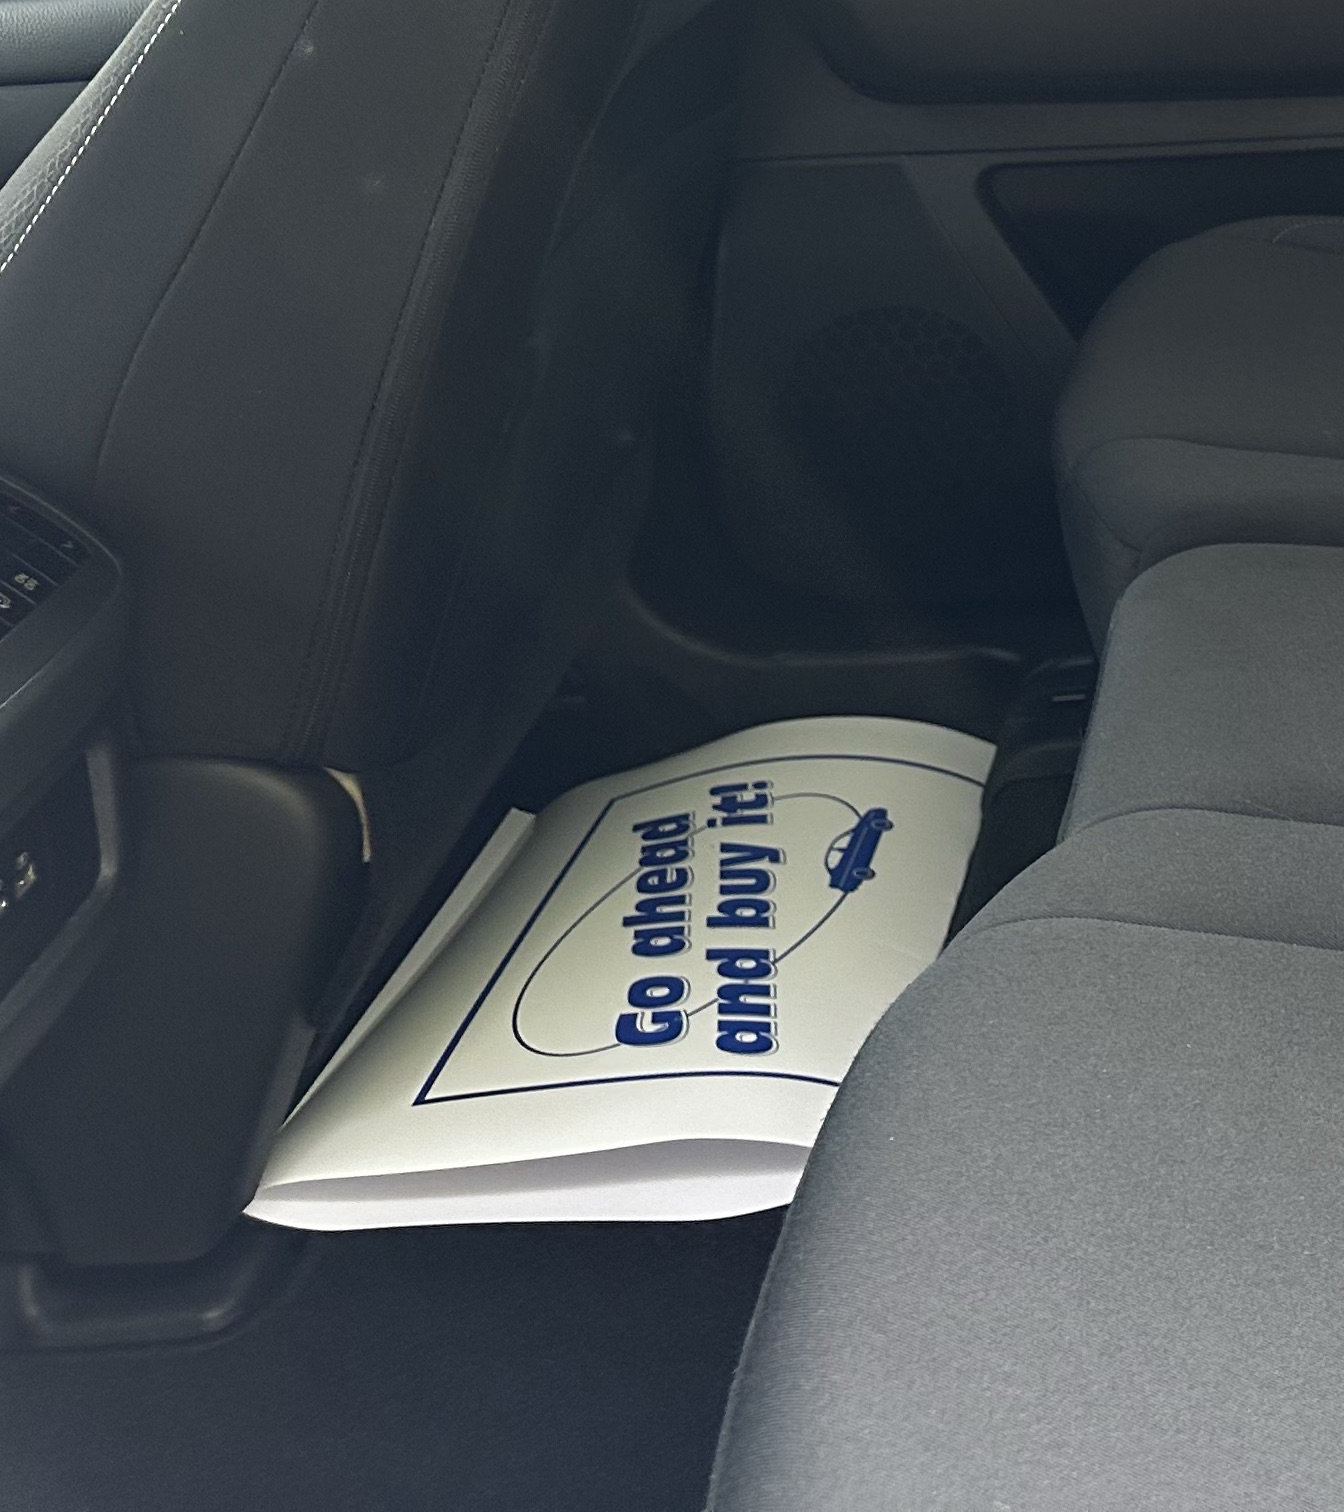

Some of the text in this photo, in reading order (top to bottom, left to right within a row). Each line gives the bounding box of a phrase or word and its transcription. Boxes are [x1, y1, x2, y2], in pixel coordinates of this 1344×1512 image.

[615, 811, 696, 1048] Go ahead
[704, 779, 787, 1056] and buy it!
